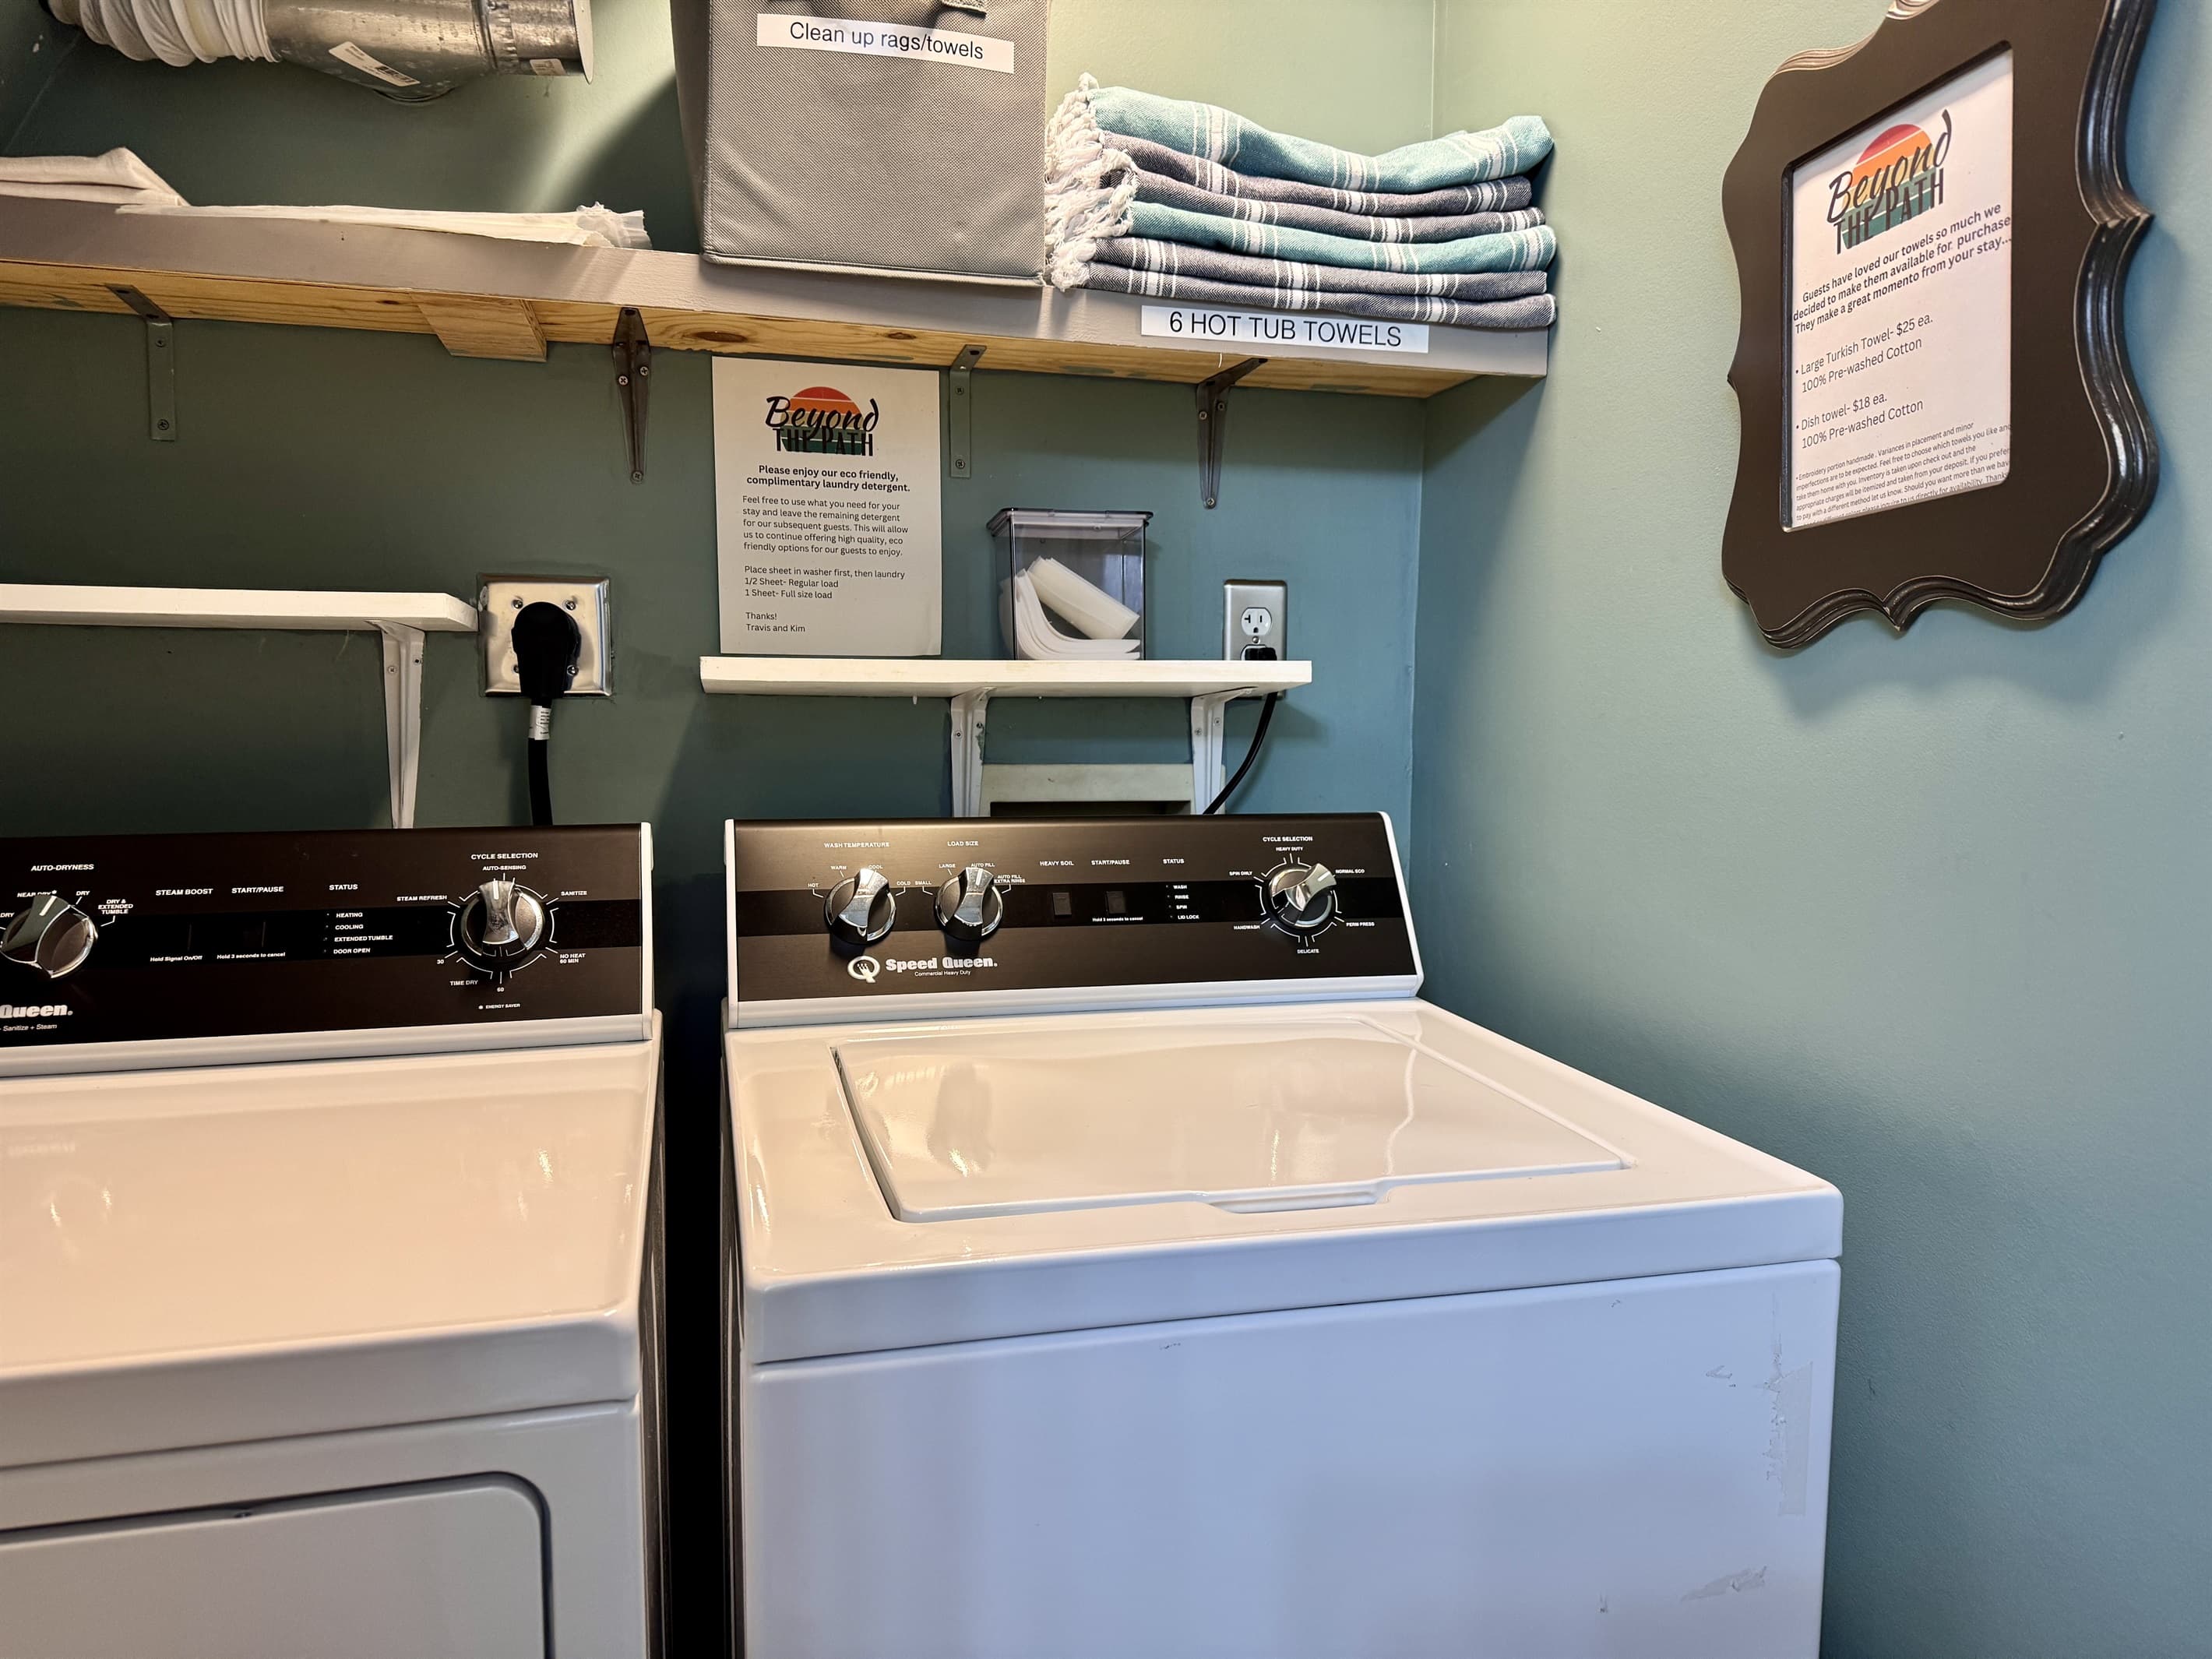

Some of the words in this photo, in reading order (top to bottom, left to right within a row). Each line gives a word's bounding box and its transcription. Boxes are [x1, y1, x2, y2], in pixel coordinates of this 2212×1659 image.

[790, 22, 845, 43] Clean
[851, 30, 874, 48] up
[880, 33, 984, 60] rags/towels
[1826, 108, 1952, 224] Beyond
[1833, 204, 1874, 255] THE
[1886, 167, 1944, 231] PATH
[1793, 297, 1826, 321] decided
[1827, 295, 1837, 305] to
[1838, 284, 1862, 300] make
[1864, 271, 1888, 288] them
[1890, 249, 1935, 276] available
[1936, 241, 1952, 255] for
[1957, 217, 2011, 249] purchase
[1802, 284, 1830, 302] Guests
[1832, 273, 1852, 288] have
[1855, 256, 1880, 277] loved
[1883, 250, 1900, 265] our
[1901, 234, 1933, 255] towels
[1936, 228, 1947, 240] so
[1950, 211, 1981, 234] much
[1984, 204, 2001, 218] we
[1795, 319, 1815, 333] They
[1817, 308, 1838, 325] make
[1840, 305, 1846, 314] a
[1847, 293, 1871, 313] great
[1873, 273, 1919, 299] momento
[1921, 260, 1946, 278] from
[1948, 248, 1974, 269] your
[1169, 312, 1182, 333] 6
[1191, 313, 1242, 336] HOT
[1249, 317, 1296, 339] TUB
[1303, 320, 1401, 347] TOWELS
[1801, 358, 1824, 375] Large
[1826, 343, 1858, 364] Turkish
[1861, 329, 1894, 349] Towel-
[1897, 321, 1914, 336] $25
[1918, 315, 1933, 327] ea.
[1802, 374, 1826, 393] 100%
[1829, 350, 1883, 382] Pre-washed
[1886, 339, 1921, 360] Cotton
[765, 396, 879, 440] Beyond
[1802, 414, 1819, 430] Dish
[1822, 403, 1851, 423] towel-
[1853, 396, 1870, 413] $18
[1872, 394, 1887, 405] ea.
[1802, 431, 1827, 449] 100%
[1829, 410, 1885, 439] Pre-washed
[1888, 400, 1923, 420] Cotton
[773, 428, 811, 453] THE
[822, 425, 873, 456] PATH
[1878, 444, 1905, 456] Variances
[1911, 431, 1942, 448] placement
[1943, 427, 1954, 437] and
[1955, 422, 1974, 433] minor
[746, 477, 820, 489] complimentary
[822, 479, 859, 491] laundry
[861, 481, 910, 493] detergent.
[759, 465, 790, 475] Please
[793, 467, 819, 478] enjoy
[859, 470, 898, 482] friendly,
[743, 508, 760, 517] stay
[819, 512, 859, 522] remaining
[861, 512, 900, 523] detergent
[762, 496, 779, 505] free
[807, 498, 827, 507] what
[788, 579, 819, 588] Regular
[834, 569, 852, 578] first,
[875, 570, 905, 579] laundry
[886, 957, 938, 973] Speed
